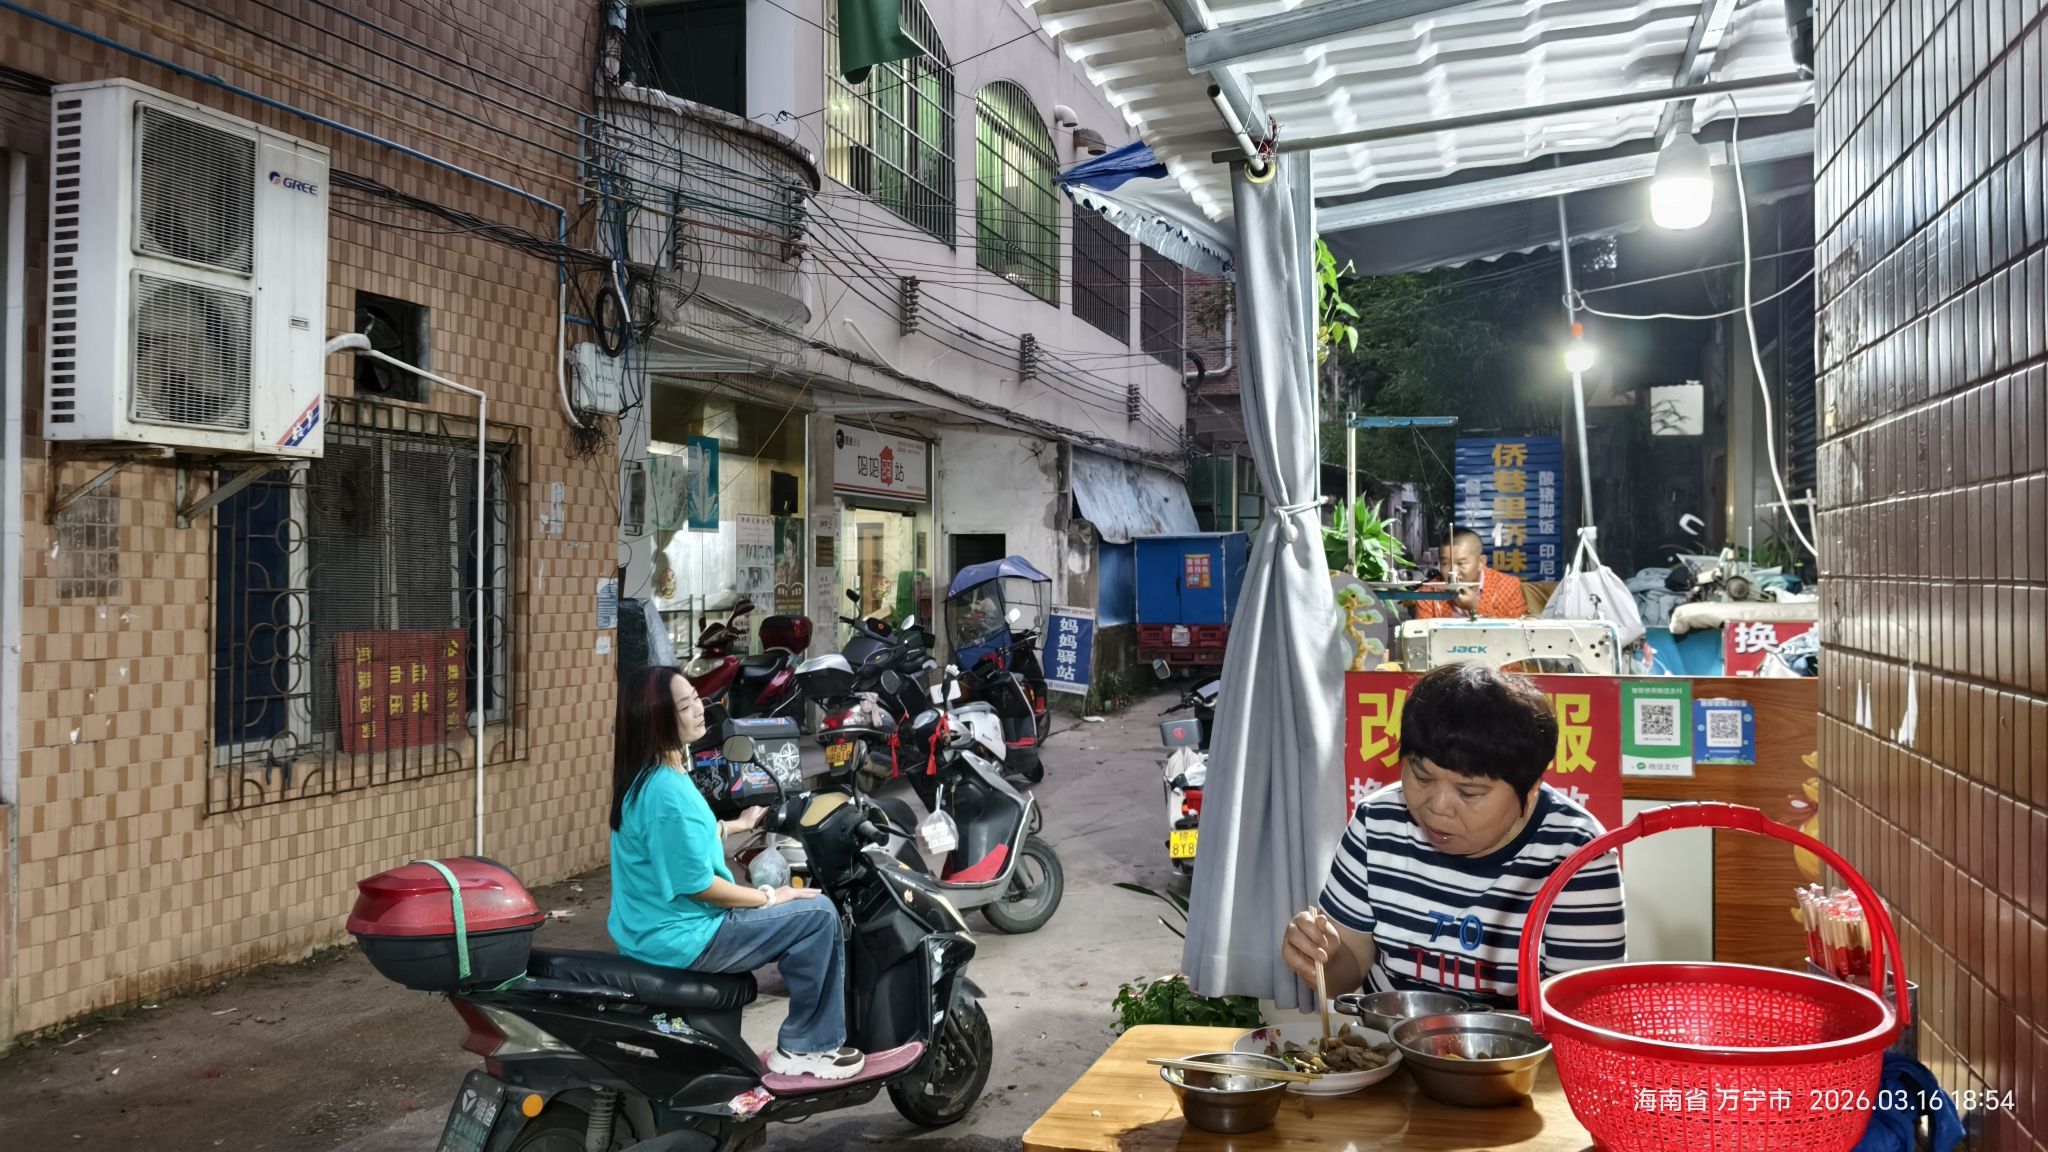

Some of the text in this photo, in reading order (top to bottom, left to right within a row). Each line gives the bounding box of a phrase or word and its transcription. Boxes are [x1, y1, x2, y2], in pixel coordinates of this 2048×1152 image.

[282, 177, 318, 196] GREE
[1538, 471, 1555, 582] 酸猪脚饭 印尼
[1056, 617, 1079, 681] 妈妈驿站
[1358, 688, 1597, 774] 改服
